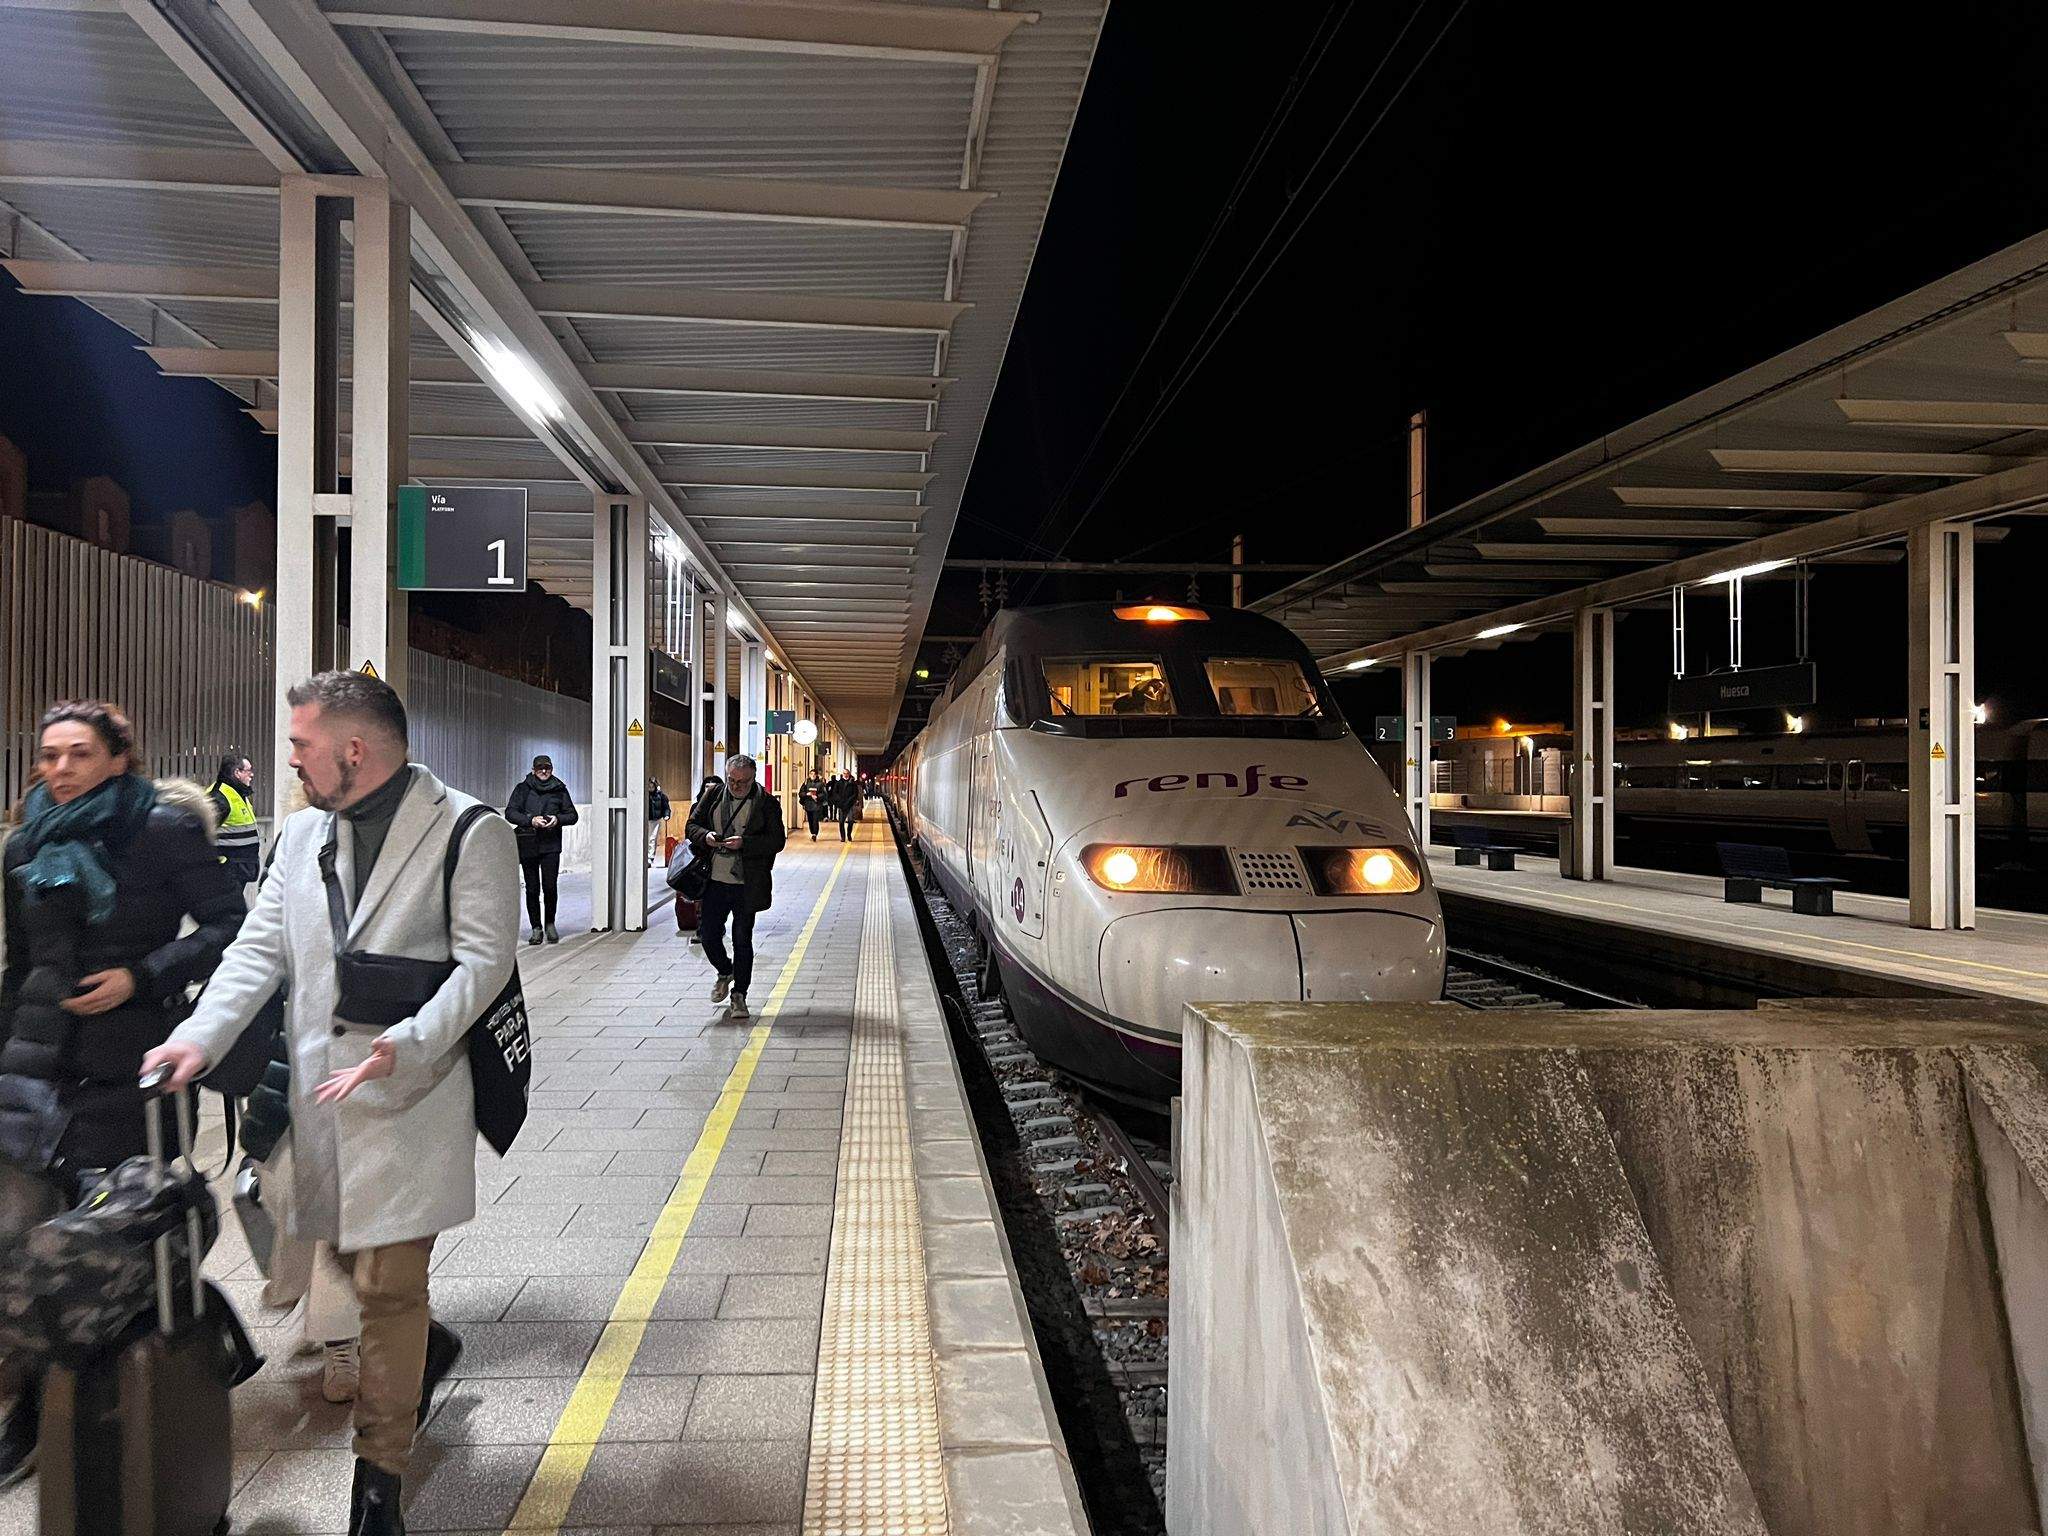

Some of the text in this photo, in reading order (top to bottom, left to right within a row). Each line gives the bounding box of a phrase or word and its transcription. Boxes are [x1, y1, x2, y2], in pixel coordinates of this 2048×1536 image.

[431, 494, 446, 504] Vía
[487, 539, 514, 585] 1
[1720, 685, 1750, 698] Huesca
[786, 722, 794, 734] 1
[1379, 728, 1386, 740] 2
[1447, 728, 1454, 740] 3
[1114, 765, 1309, 798] renfe
[1286, 808, 1387, 839] AVE
[494, 1011, 525, 1048] PARA
